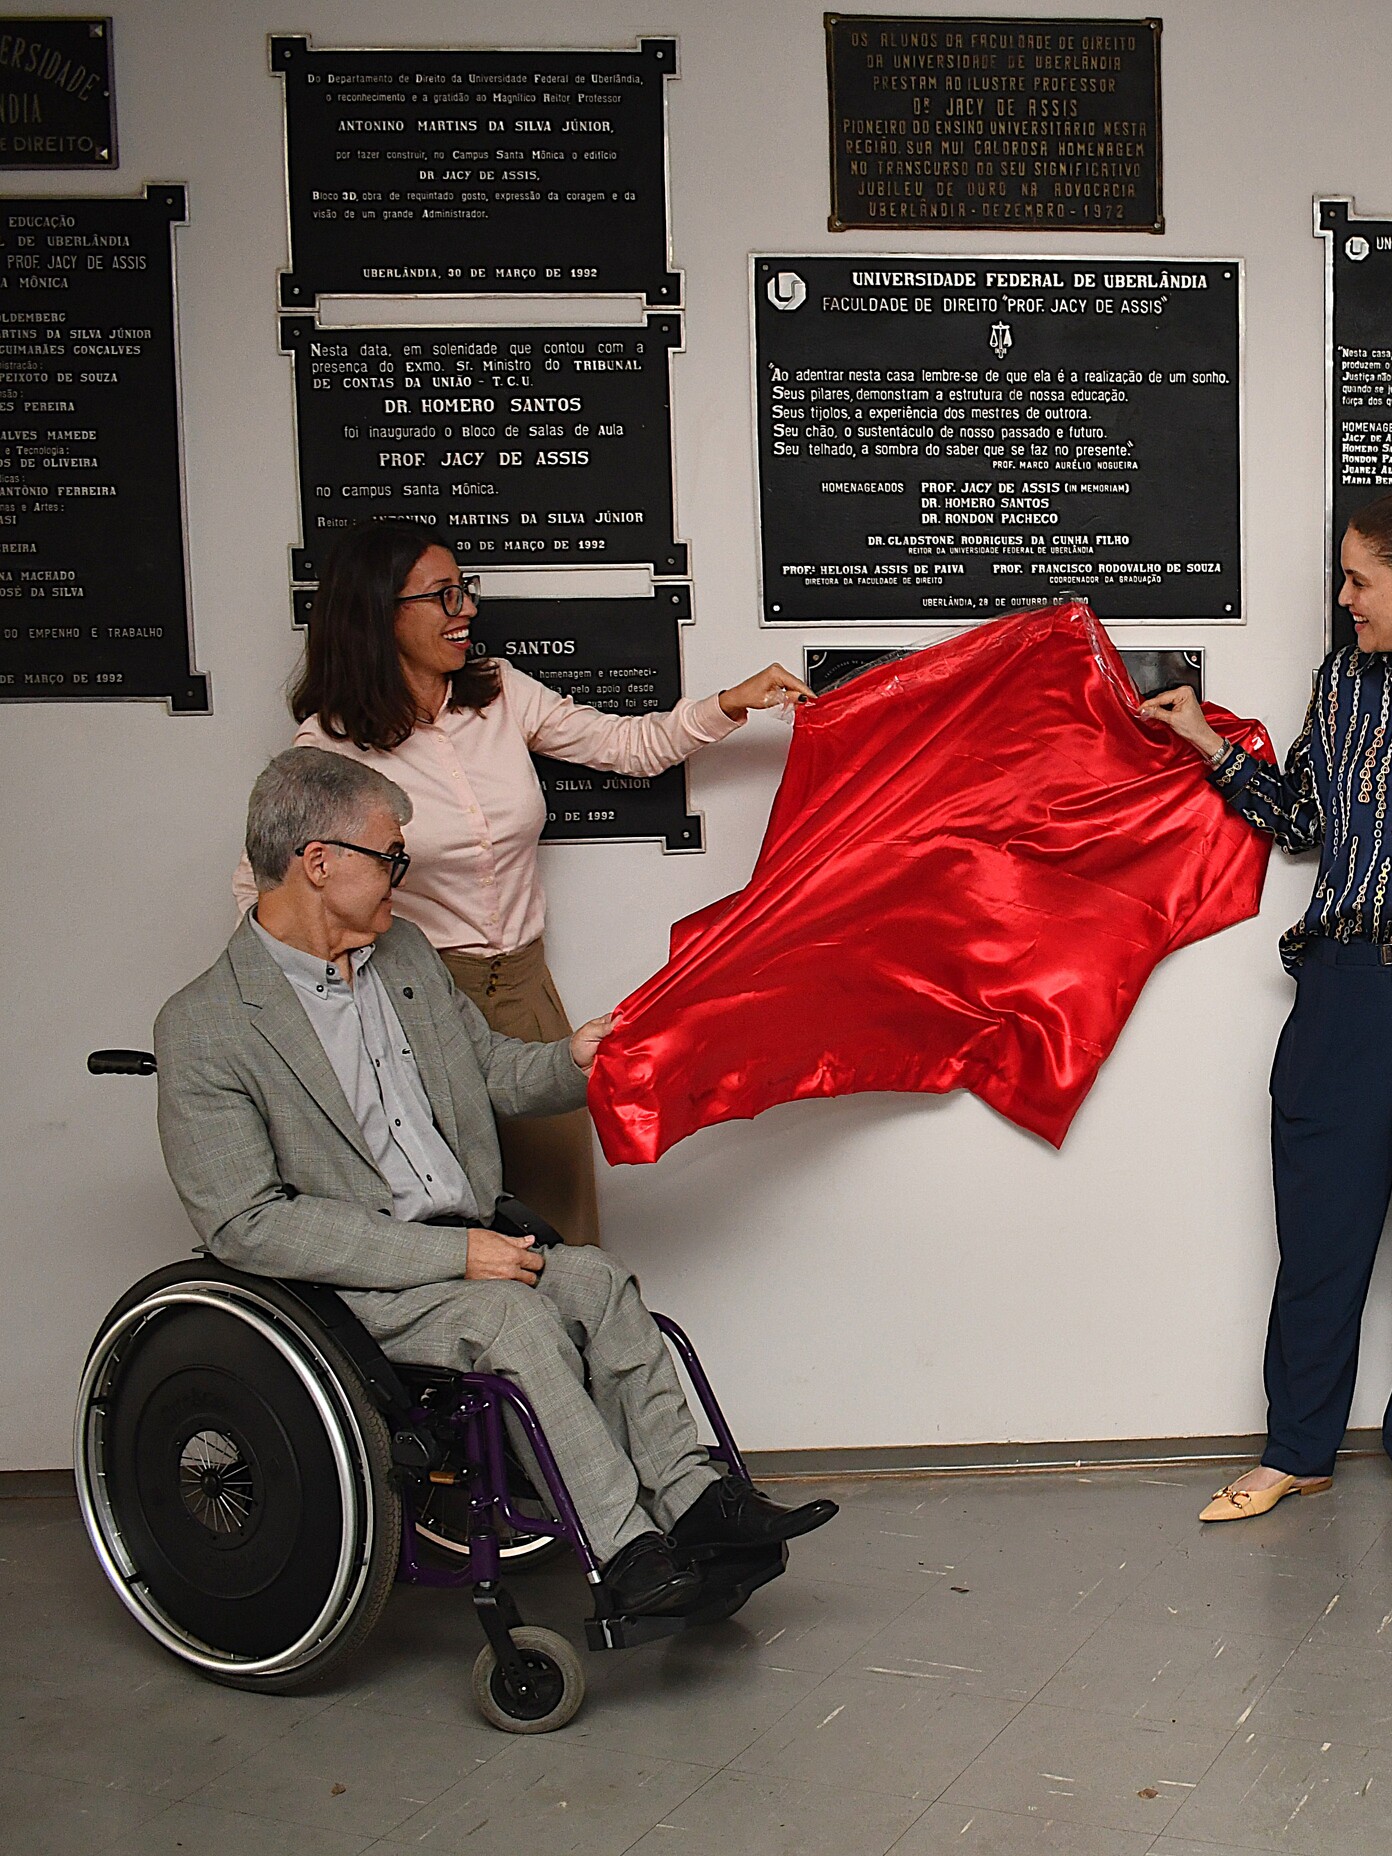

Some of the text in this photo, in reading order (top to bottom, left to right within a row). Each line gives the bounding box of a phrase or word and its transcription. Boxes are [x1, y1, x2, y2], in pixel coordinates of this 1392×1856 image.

[308, 74, 320, 83] Do
[328, 74, 392, 84] Departamento
[398, 74, 410, 83] de
[416, 74, 445, 83] Direito
[452, 75, 462, 83] da
[469, 74, 527, 83] Universidade
[534, 74, 568, 83] Federal
[575, 75, 585, 83] de
[873, 75, 1116, 93] PRESTAM AO ILUSTRE PROFESSOR
[945, 97, 1078, 118] JACY DE ASSIS
[339, 121, 404, 131] ANTONINO
[418, 121, 477, 131] MARTINS
[489, 121, 504, 131] DA
[515, 121, 551, 131] SILVA
[13, 135, 94, 153] DIREITO
[443, 171, 471, 179] JACY
[480, 171, 494, 179] DE
[8, 214, 76, 229] EDUCAÇÃO
[18, 234, 129, 246] DE UBERLÂNDIA
[47, 255, 78, 270] JACY
[87, 255, 104, 270] DE
[112, 255, 147, 270] ASSIS
[448, 269, 461, 277] 30
[471, 269, 485, 277] DE
[496, 269, 536, 279] MARÇO
[546, 269, 561, 277] DE
[571, 269, 597, 277] 1992
[852, 270, 1208, 289] UNIVERSIDADE FEDERAL DE UBERLÂNDIA
[822, 297, 909, 312] FACULDADE
[914, 297, 933, 313] DE
[943, 297, 998, 313] DIREITO
[1050, 298, 1087, 313] JACY
[1095, 298, 1114, 314] DE
[47, 328, 151, 339] DA SILVA JÚNIOR
[74, 346, 140, 355] GONÇALVES
[310, 342, 643, 357] Nesta data, em solenidade que contou com a
[57, 373, 117, 382] DE SOUZA
[314, 379, 330, 388] DE
[343, 378, 394, 388] CONTAS
[405, 378, 421, 387] DA
[433, 375, 471, 387] UNIÃO
[24, 402, 74, 411] PEREIRA
[384, 397, 582, 414] DR. HOMERO SANTOS
[771, 404, 1091, 422] Seus tijolos, a experiência dos mestres de outrora.
[48, 431, 96, 440] MAMEDE
[21, 458, 97, 467] DE OLIVEIRA
[379, 450, 589, 467] PROF. JACY DE ASSIS
[1020, 461, 1048, 469] MARCO
[1056, 459, 1091, 469] AURÉLIO
[1097, 461, 1138, 469] NOGUEIRA
[58, 487, 116, 495] FERREIRA
[822, 483, 903, 492] HOMENAGEADOS
[922, 483, 956, 492] PROF.
[961, 483, 992, 493] JACY
[999, 483, 1014, 493] DE
[1022, 483, 1060, 493] ASSIS
[922, 498, 1049, 508] DR. HOMERO SANTOS
[450, 511, 643, 525] MARTINS DA SILVA JÚNIOR
[922, 513, 1058, 524] DR. RONDON PACHECO
[993, 563, 1220, 573] PROF. FRANCISCO RODOVALHO DE SOUZA
[29, 628, 162, 638] EMPENHO E TRABALHO
[505, 640, 575, 655] SANTOS
[25, 674, 122, 684] MARÇO DE 1992
[539, 670, 591, 680] homenagem
[556, 776, 652, 791] SILVA JÚNIOR
[565, 811, 614, 821] DE 1992
